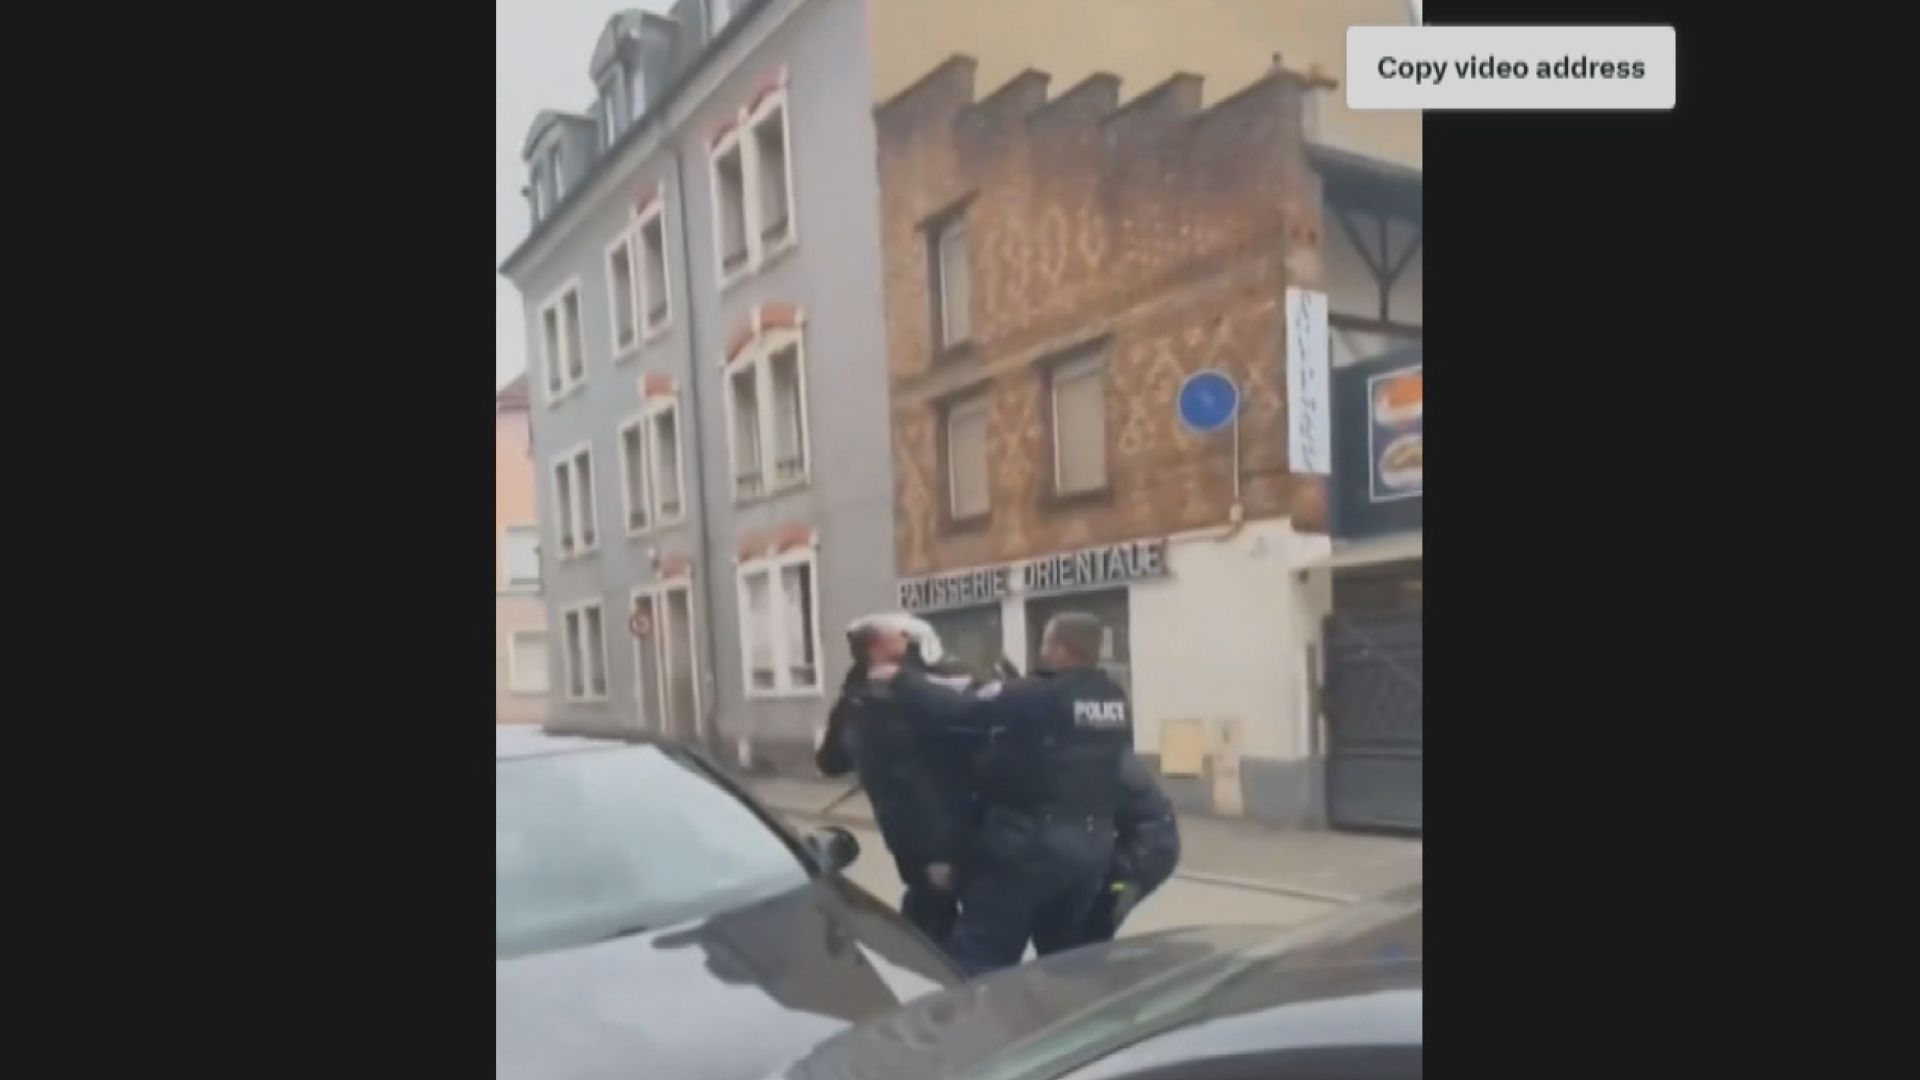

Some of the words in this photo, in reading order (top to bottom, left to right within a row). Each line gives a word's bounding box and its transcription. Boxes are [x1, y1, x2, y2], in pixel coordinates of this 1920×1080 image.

[899, 568, 1005, 608] PATISSERIE
[1022, 540, 1162, 588] ORIENTALE
[1074, 700, 1125, 723] POLICE
